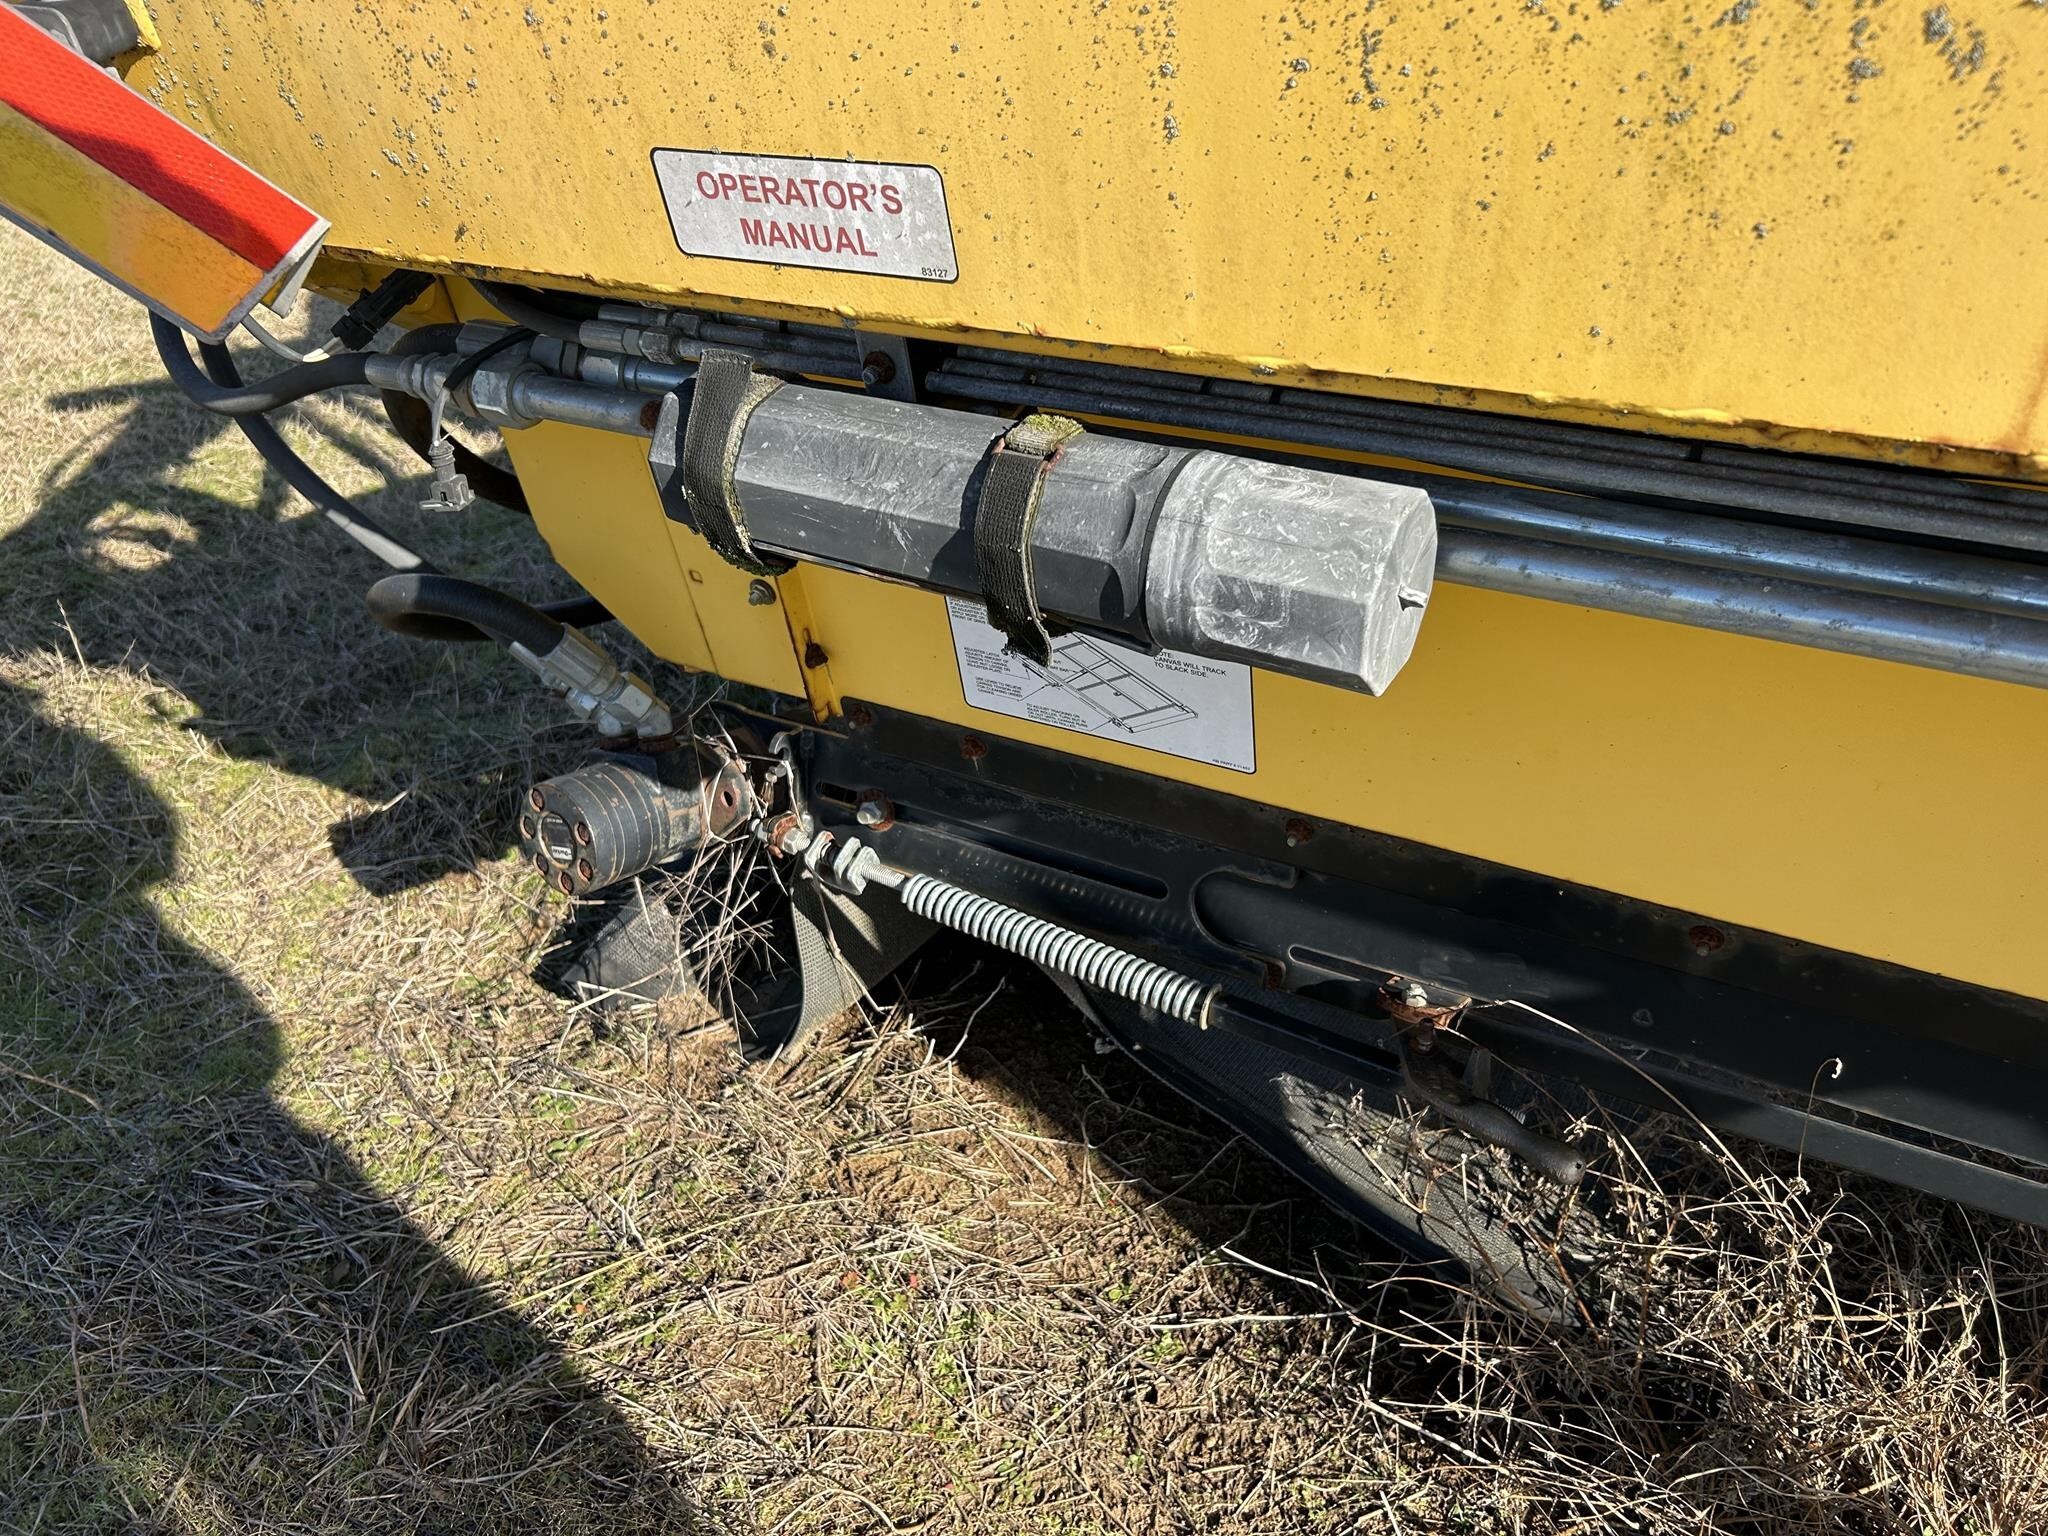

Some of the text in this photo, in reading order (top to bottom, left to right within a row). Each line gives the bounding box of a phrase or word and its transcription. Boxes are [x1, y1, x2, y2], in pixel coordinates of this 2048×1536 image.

[696, 171, 903, 215] OPERATOR'S
[740, 218, 878, 257] MANUAL
[921, 267, 949, 279] 83127
[1153, 655, 1227, 675] CANVAS WILL TRACK
[1165, 664, 1189, 673] SLACK
